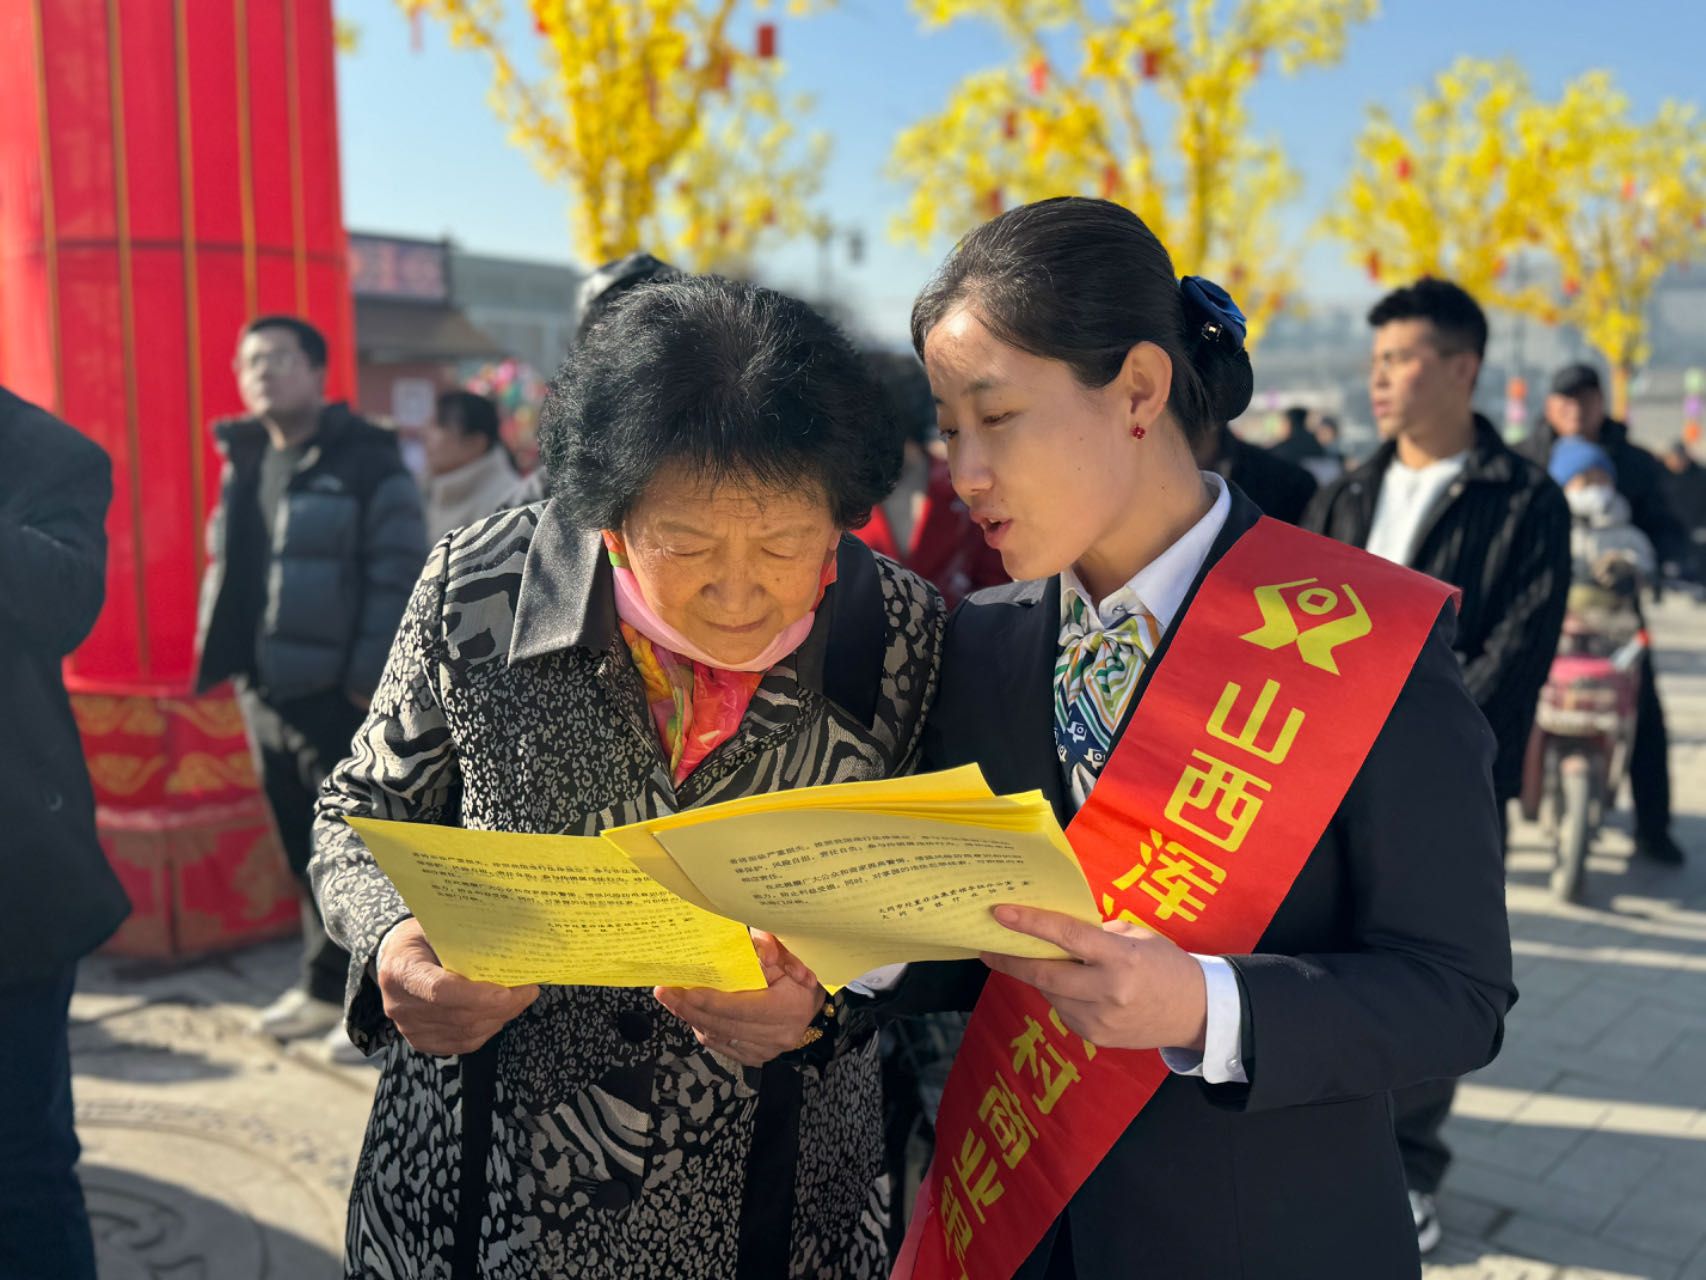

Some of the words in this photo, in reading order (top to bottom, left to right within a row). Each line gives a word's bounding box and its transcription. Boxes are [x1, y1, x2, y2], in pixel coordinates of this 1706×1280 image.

[1102, 679, 1305, 928] 山西浑
[940, 1007, 1096, 1280] 村商业银
